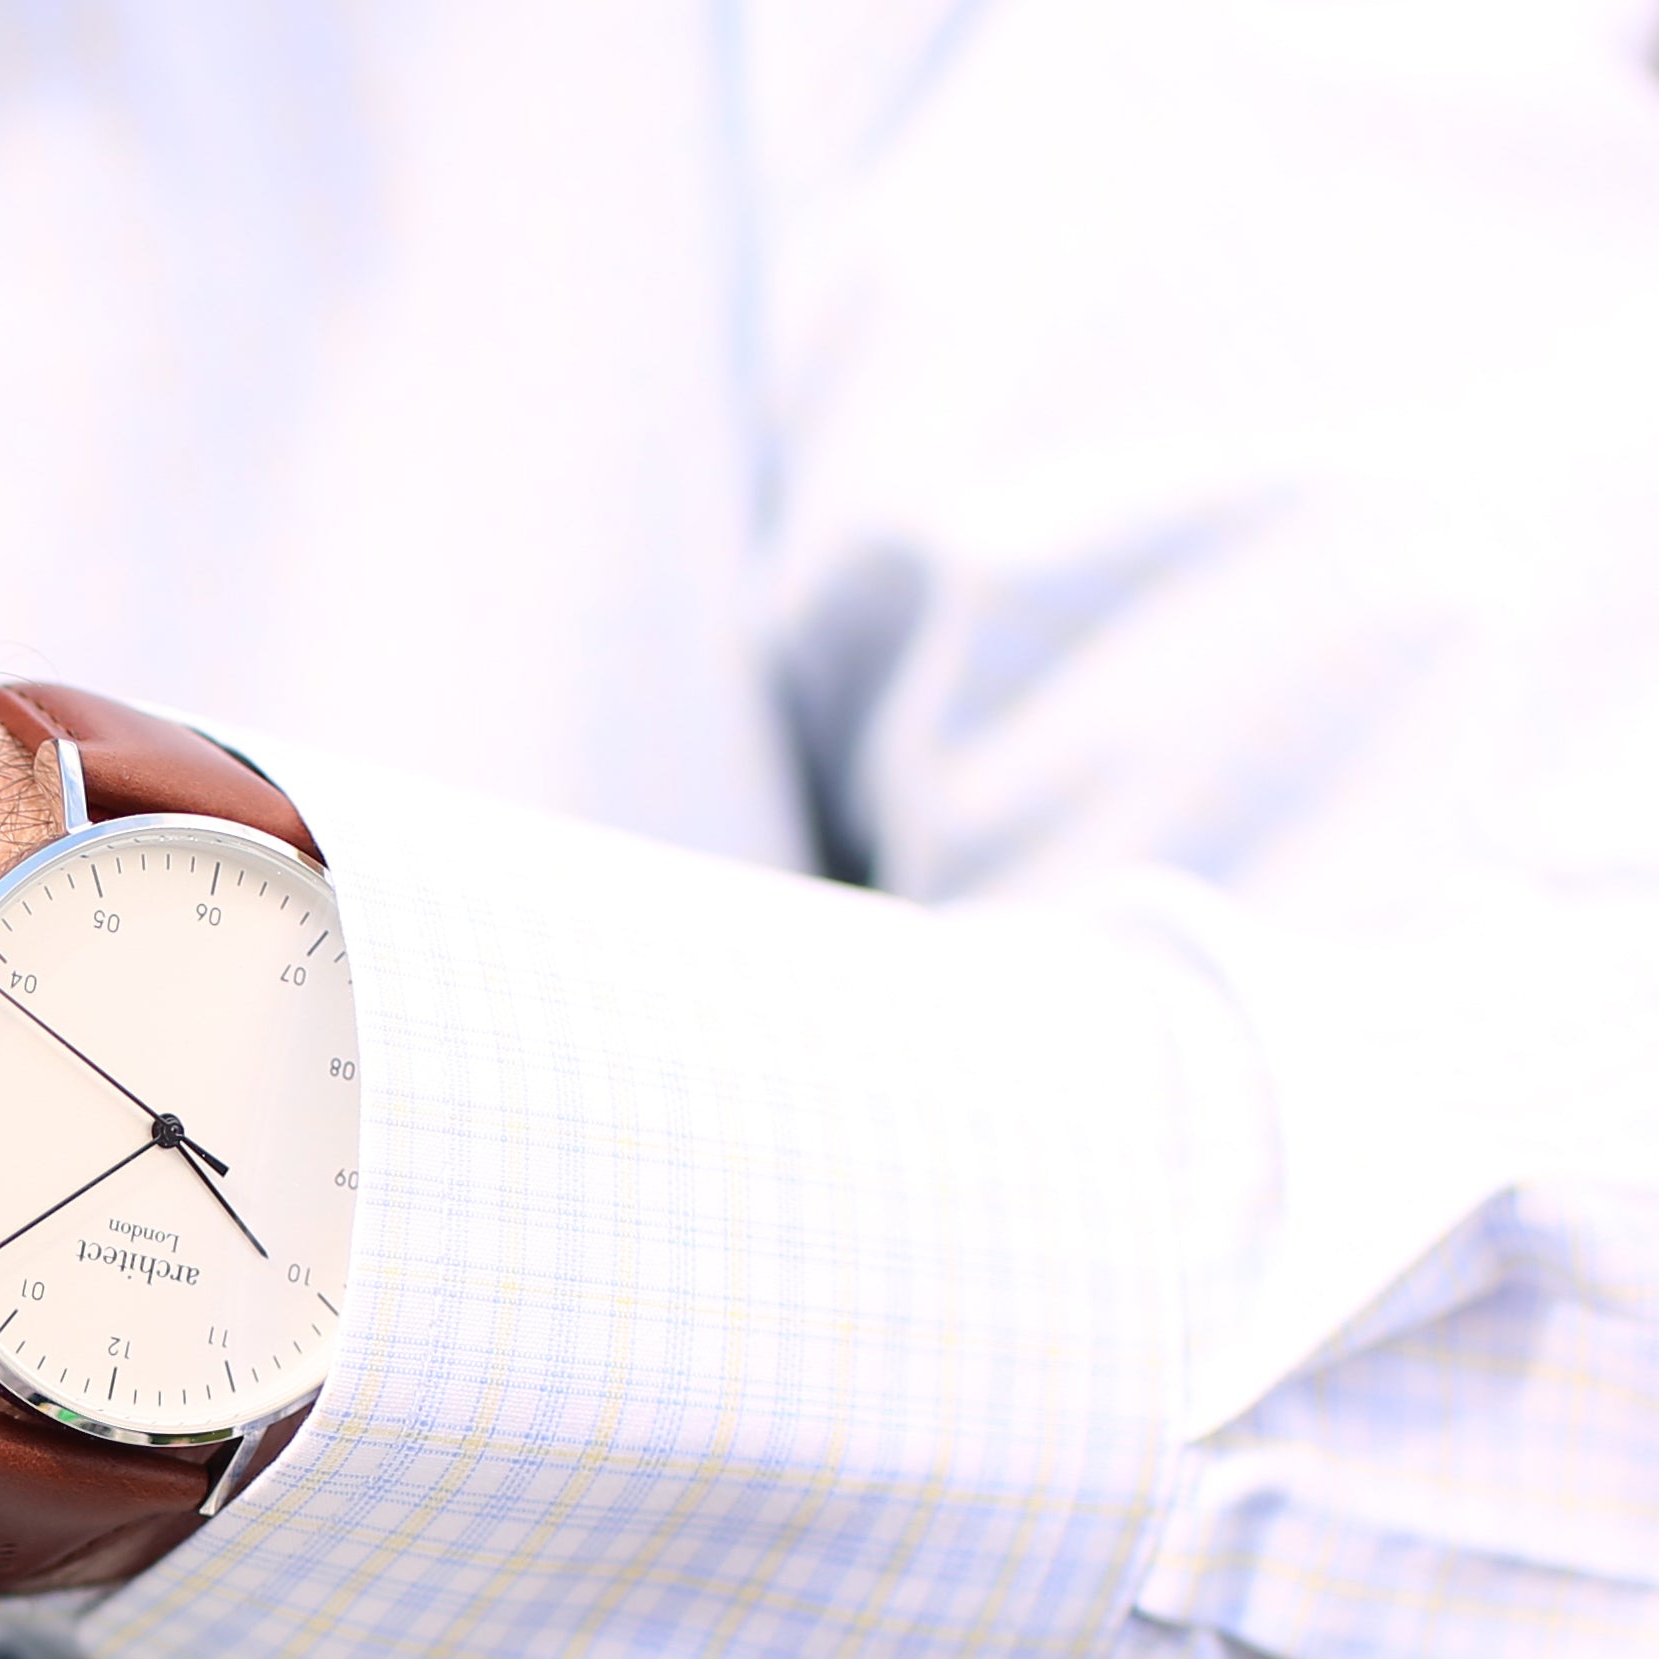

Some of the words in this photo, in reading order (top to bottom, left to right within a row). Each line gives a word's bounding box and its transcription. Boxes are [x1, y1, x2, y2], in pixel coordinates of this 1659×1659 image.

[93, 909, 121, 933] 05
[196, 903, 222, 927] 06
[10, 970, 38, 994] 04
[279, 964, 307, 987] 07
[329, 1057, 356, 1081] 08
[334, 1168, 359, 1191] 09
[108, 1218, 180, 1254] London
[76, 1238, 201, 1286] architect
[287, 1263, 311, 1287] 10
[21, 1279, 45, 1301] 01
[107, 1336, 131, 1360] 12
[208, 1326, 229, 1349] 11
